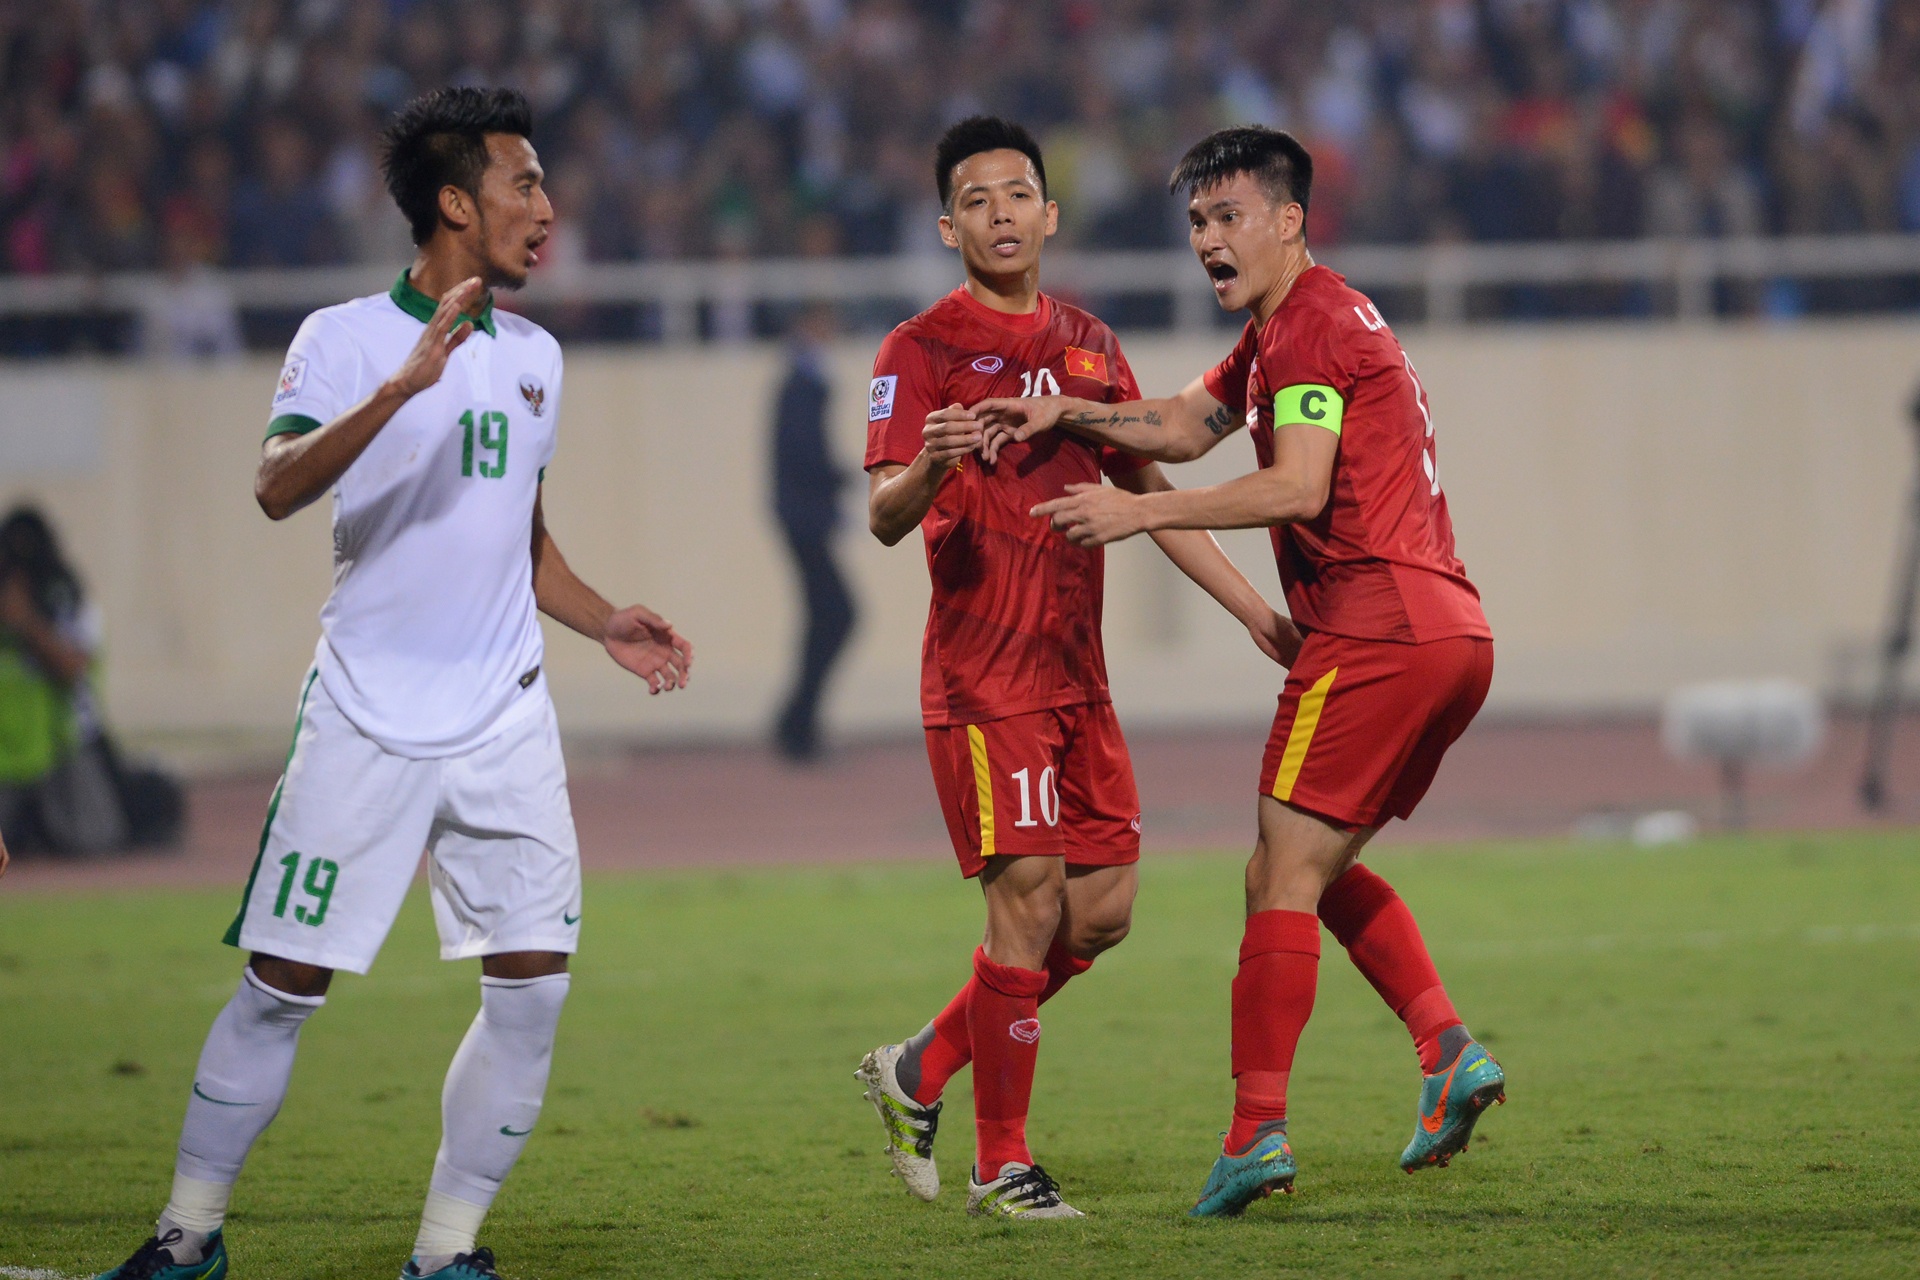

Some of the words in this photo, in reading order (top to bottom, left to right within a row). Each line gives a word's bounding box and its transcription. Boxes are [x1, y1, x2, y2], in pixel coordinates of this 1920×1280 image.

[1299, 390, 1328, 421] C
[458, 409, 509, 479] 19
[1011, 765, 1060, 827] 10
[272, 850, 339, 927] 19
